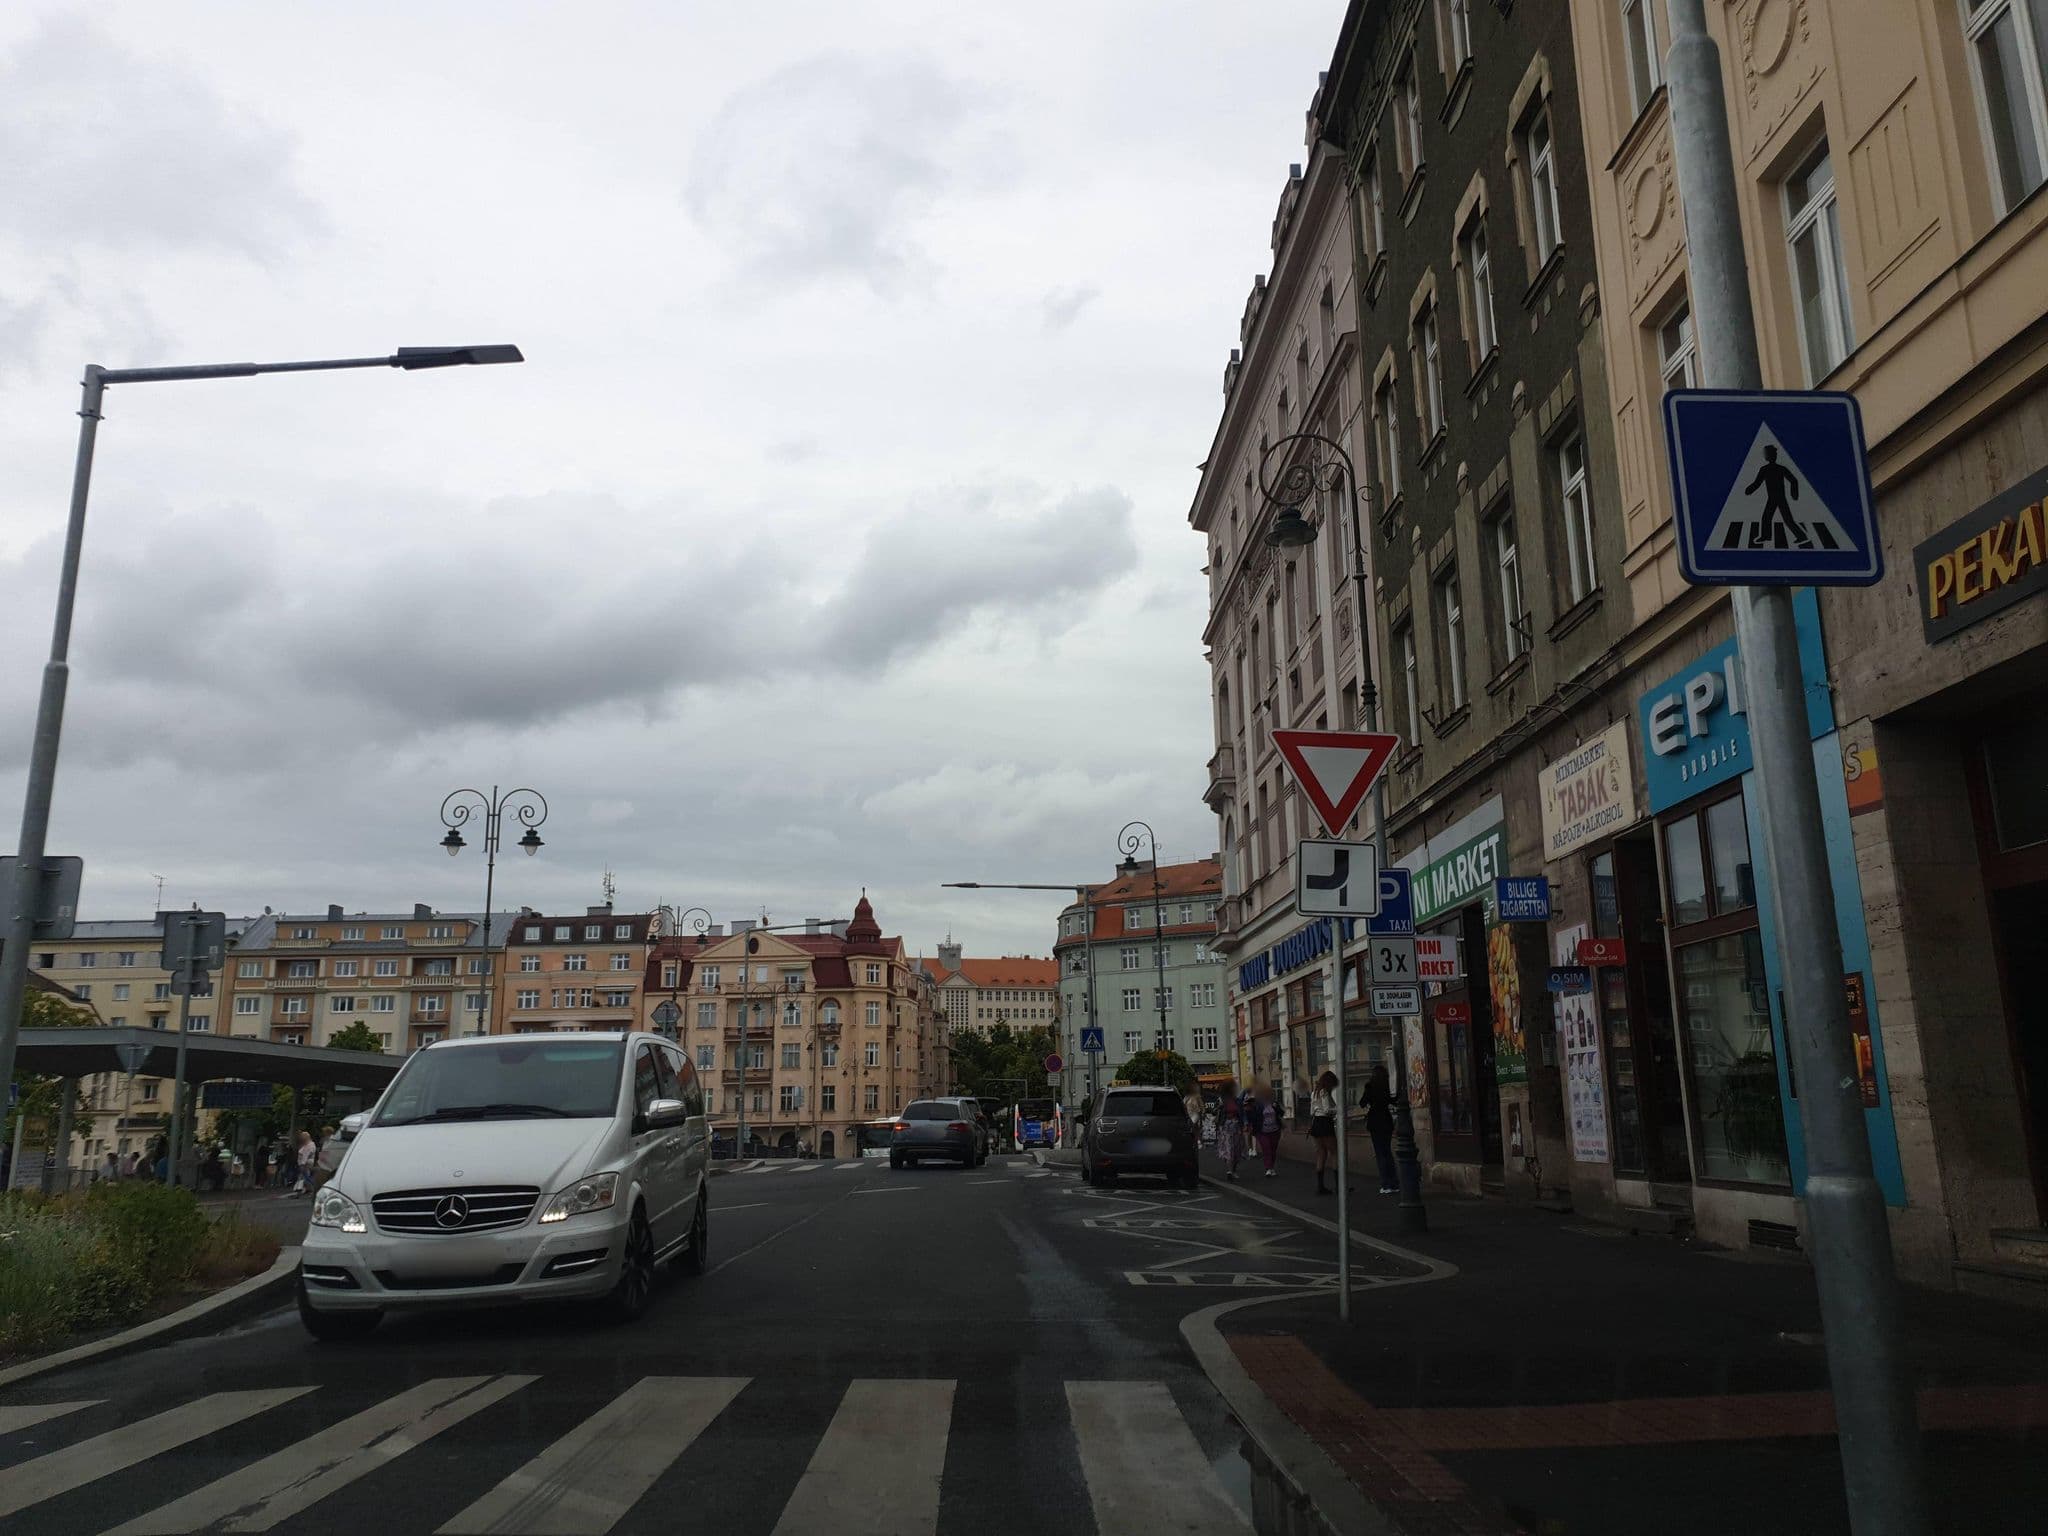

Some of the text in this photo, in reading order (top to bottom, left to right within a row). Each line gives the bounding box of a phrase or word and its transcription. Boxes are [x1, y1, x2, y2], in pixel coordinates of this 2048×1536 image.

[1928, 496, 2048, 620] PEKA
[1649, 655, 1747, 757] EPI
[1555, 741, 1606, 784] MINIMARKET
[1682, 738, 1738, 782] BUBBLE
[1558, 764, 1610, 826] TABÁK
[1413, 832, 1500, 919] NI MARKET
[1507, 882, 1538, 899] BILLIGE
[1388, 919, 1411, 931] TAXI
[1501, 900, 1548, 917] ZIGARETTEN
[1272, 916, 1354, 976] DOBROVS
[1564, 973, 1585, 984] SIM
